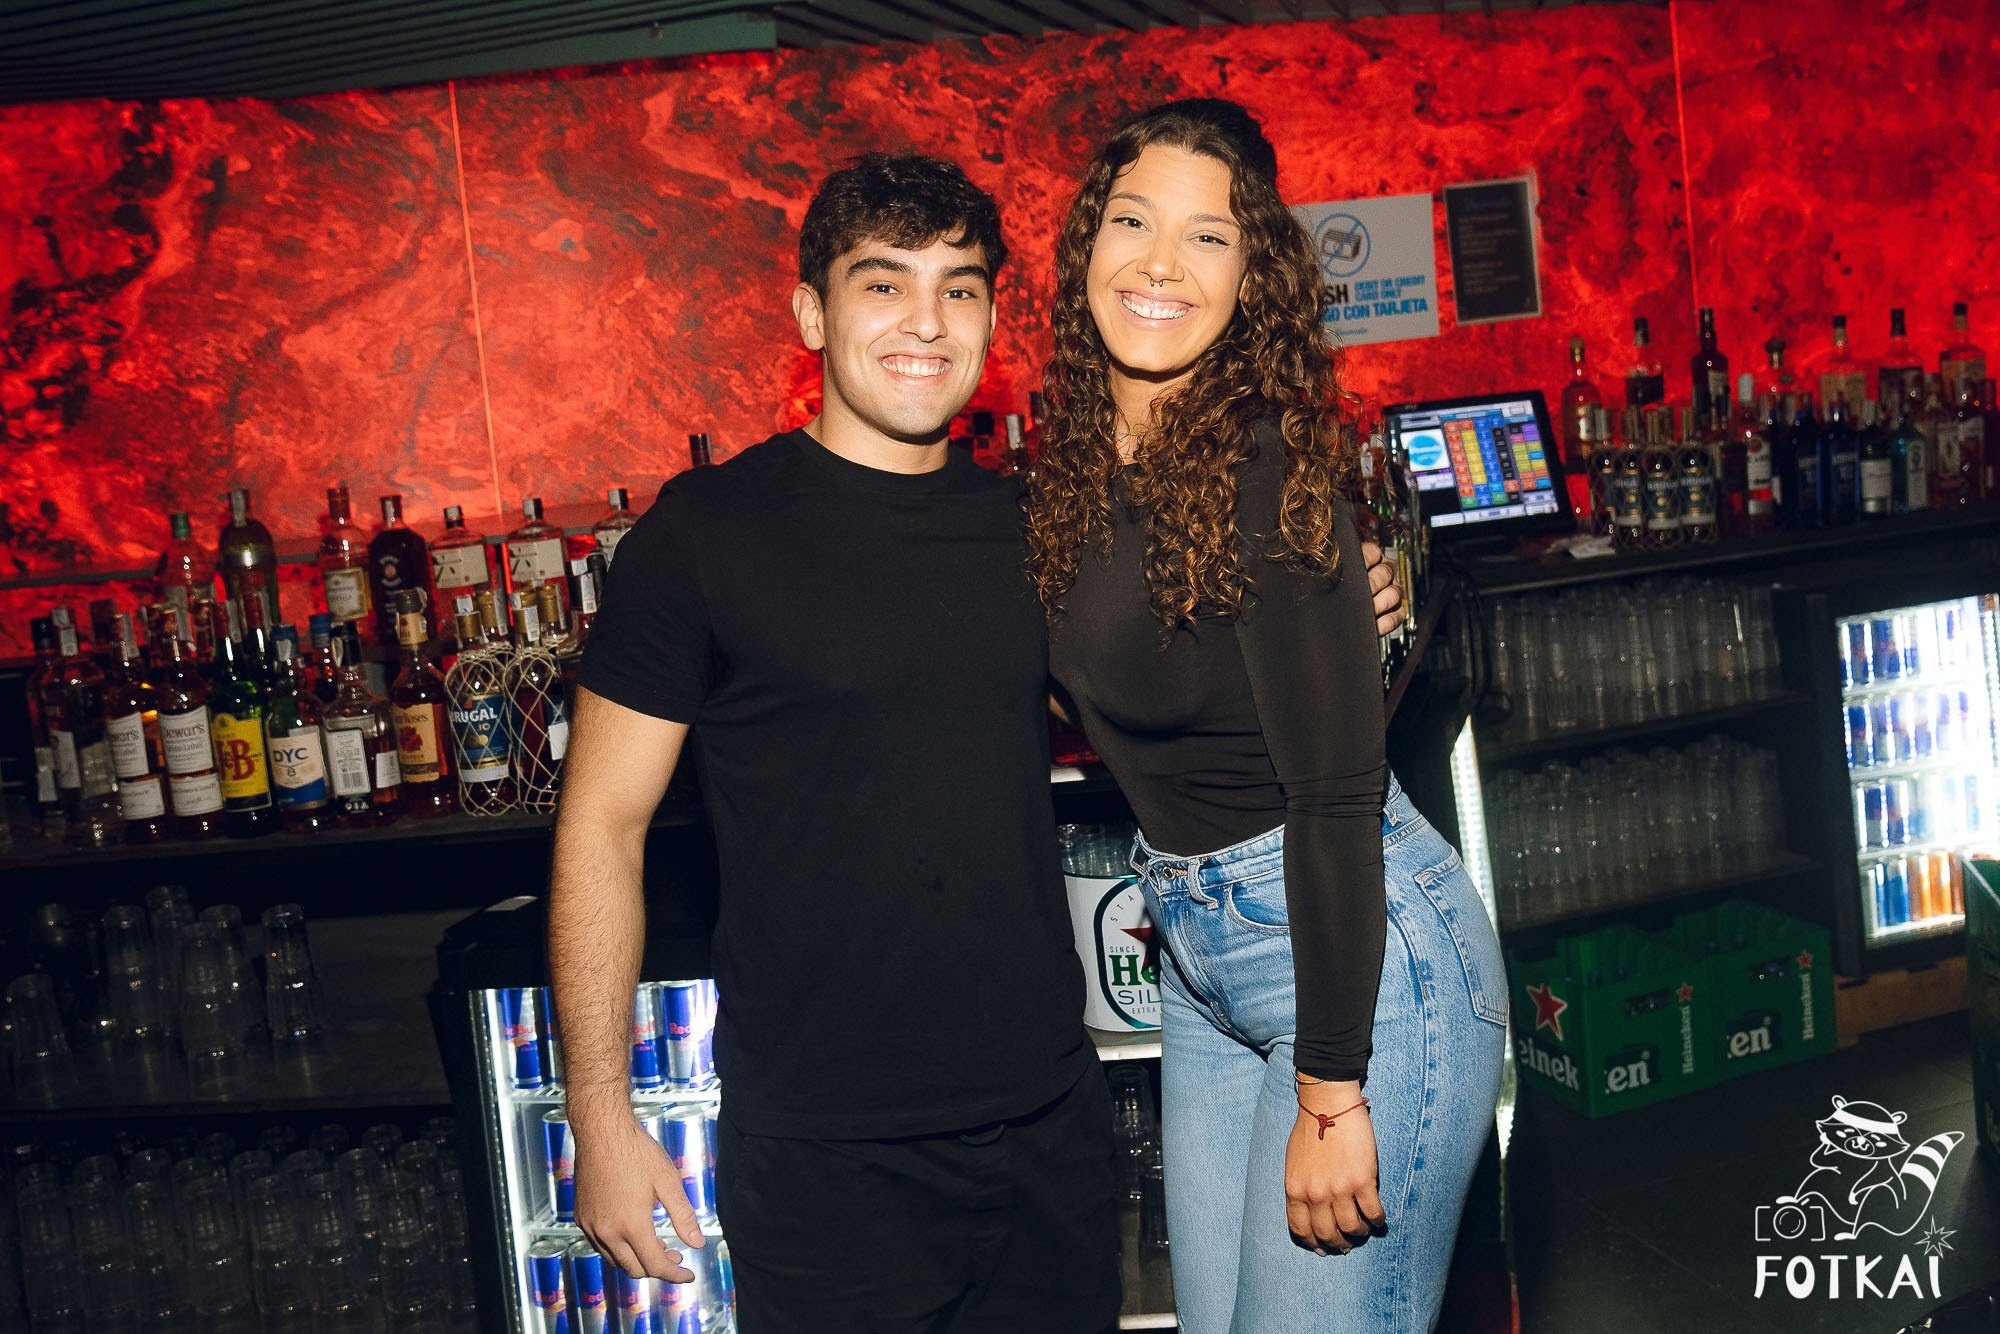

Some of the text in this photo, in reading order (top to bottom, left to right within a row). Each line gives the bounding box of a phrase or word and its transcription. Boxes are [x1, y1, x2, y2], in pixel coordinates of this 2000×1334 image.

[1324, 284, 1349, 305] SH
[1323, 298, 1428, 323] GO CON TARJETA
[272, 747, 309, 763] DYC
[1109, 945, 1137, 954] SINCE
[1118, 988, 1162, 1006] SIL
[1519, 1037, 1580, 1092] einek
